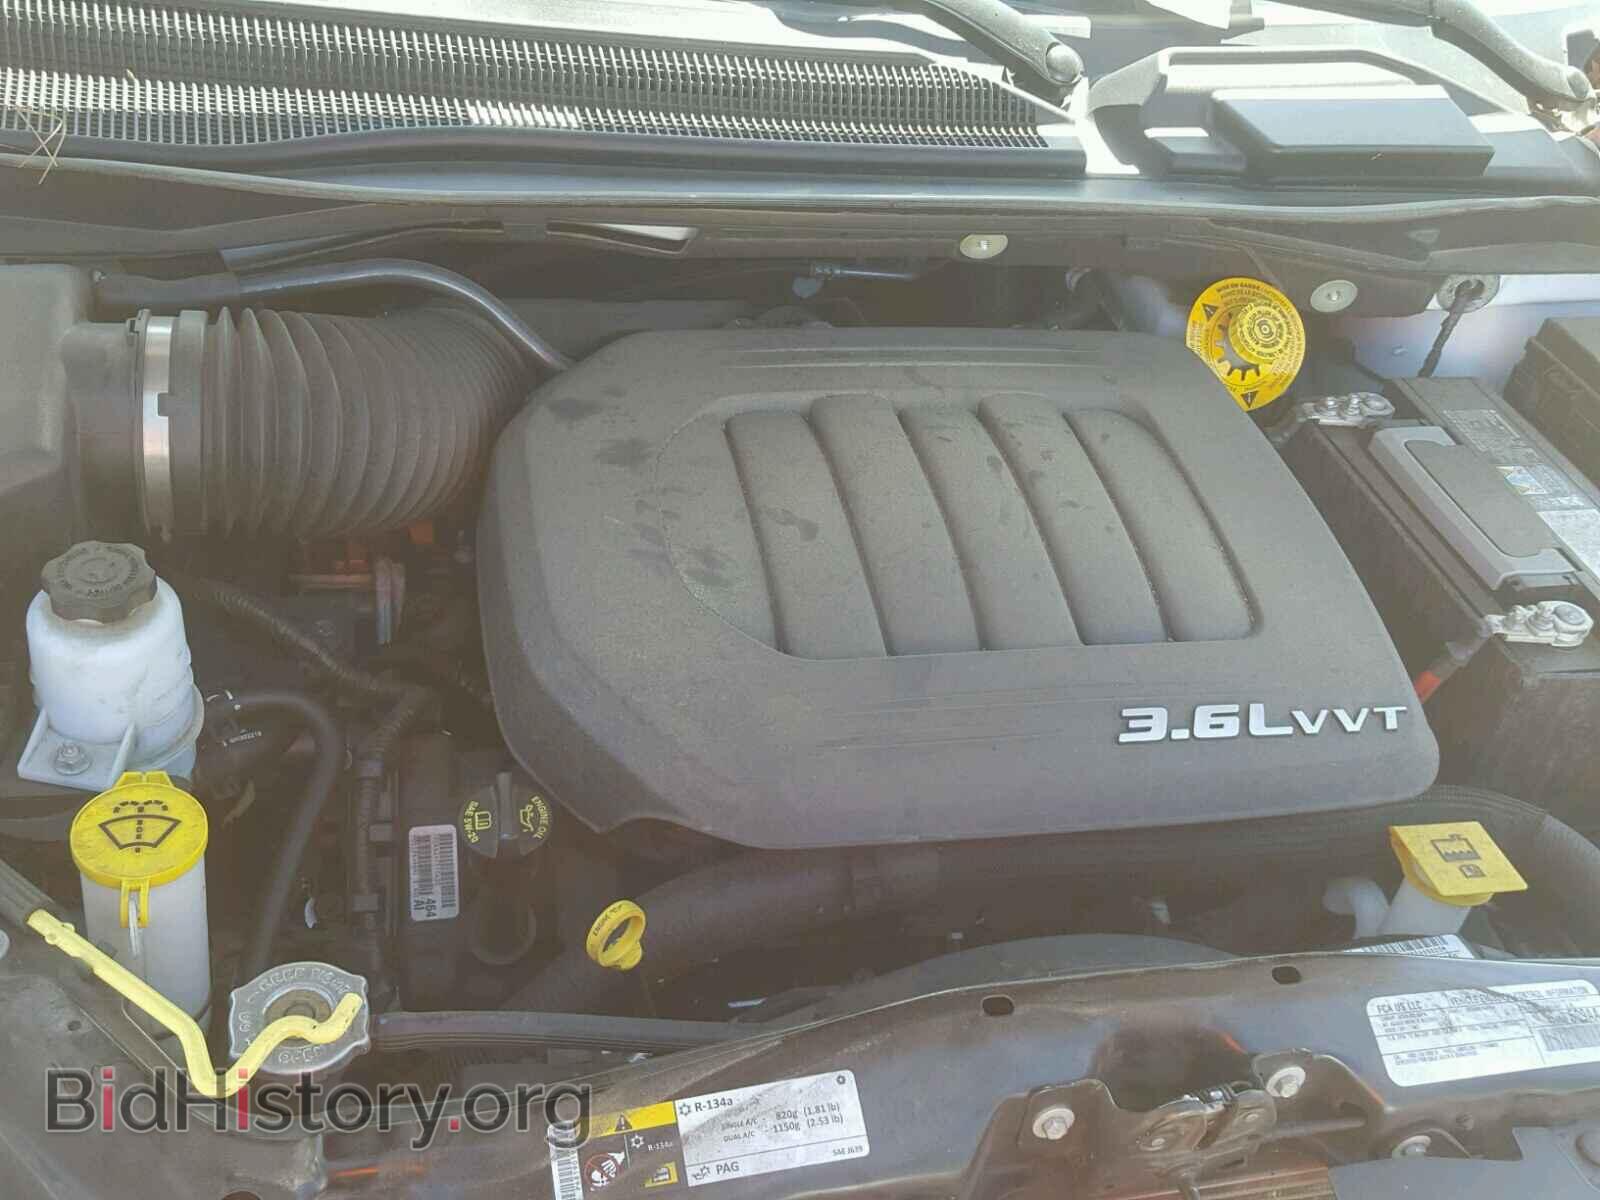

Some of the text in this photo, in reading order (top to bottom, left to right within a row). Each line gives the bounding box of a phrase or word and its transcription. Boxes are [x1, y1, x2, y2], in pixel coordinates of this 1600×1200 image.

[532, 826, 547, 839] OIL
[694, 1097, 733, 1113] R-134a
[803, 1104, 825, 1117] (1.81
[827, 1102, 840, 1114] lb)
[806, 1117, 829, 1129] (2.53
[831, 1114, 844, 1126] lb)
[716, 1161, 740, 1175] PAG
